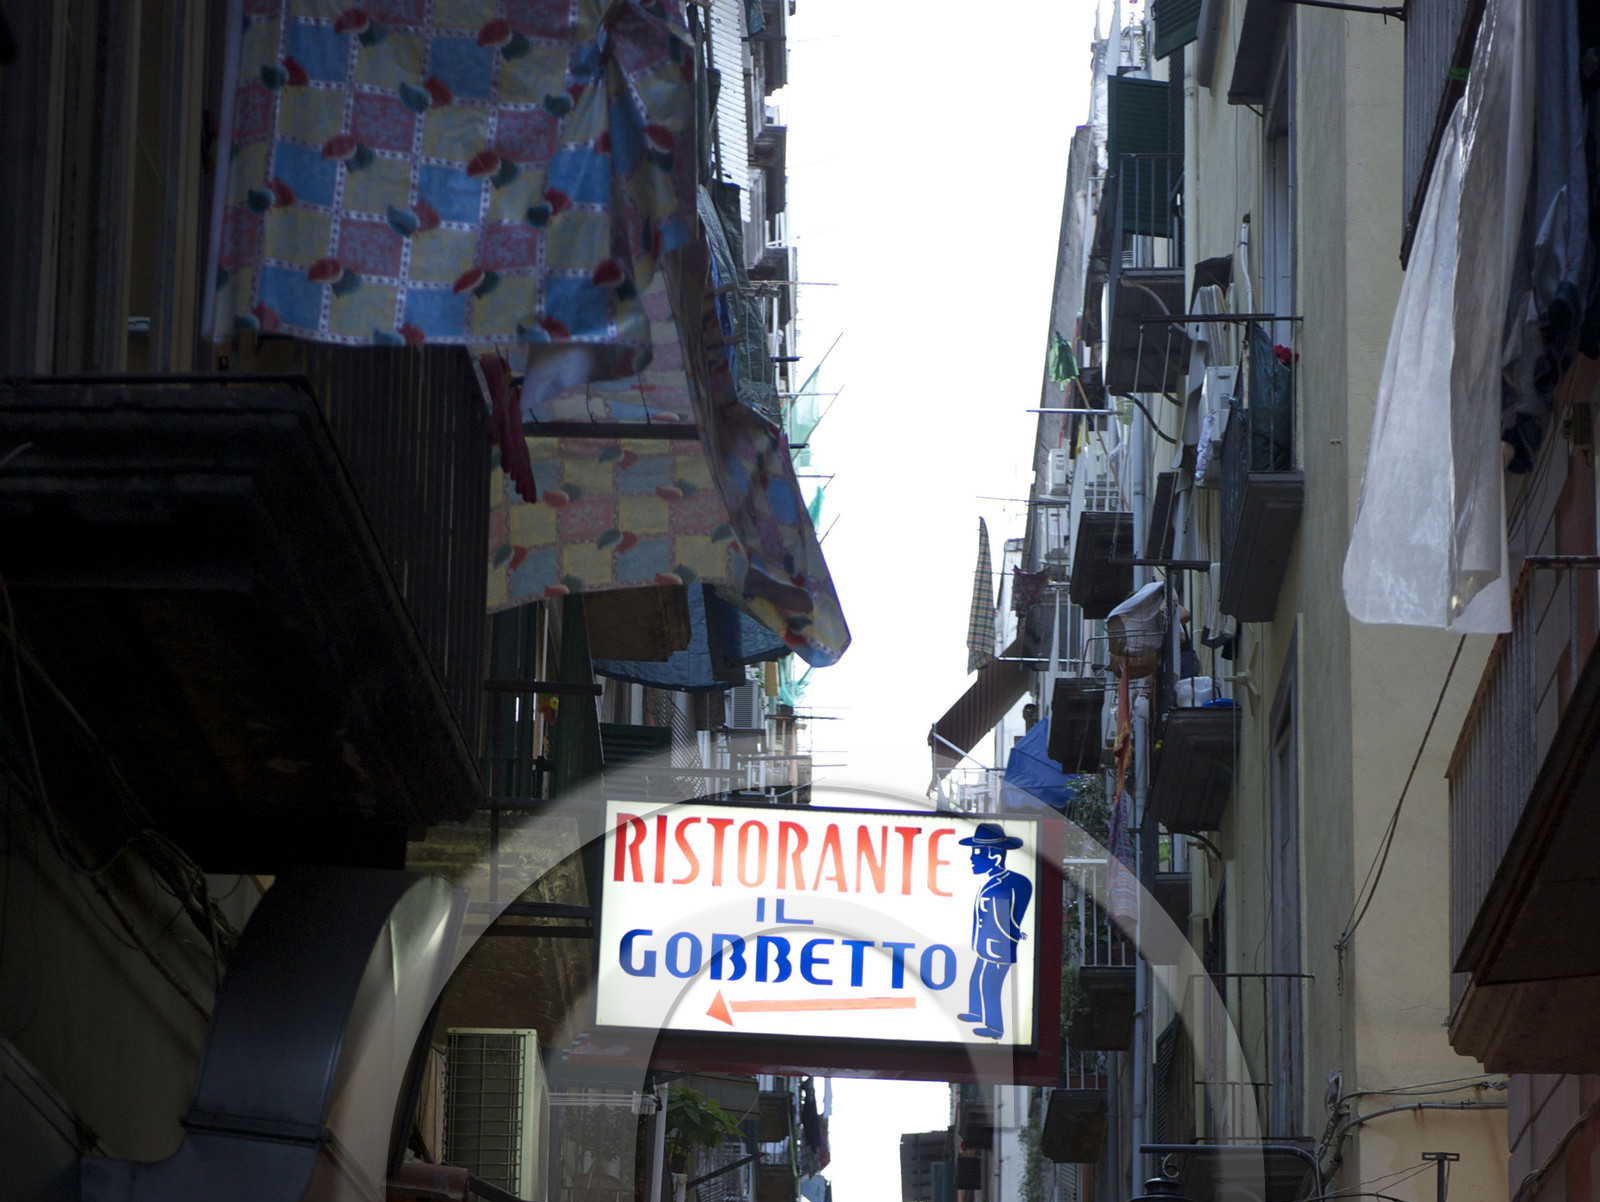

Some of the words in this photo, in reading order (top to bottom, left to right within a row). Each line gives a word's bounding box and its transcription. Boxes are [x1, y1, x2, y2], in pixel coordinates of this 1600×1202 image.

[613, 812, 956, 897] RISTORANTE
[755, 897, 814, 925] IL
[619, 928, 957, 991] GOBBETTO
